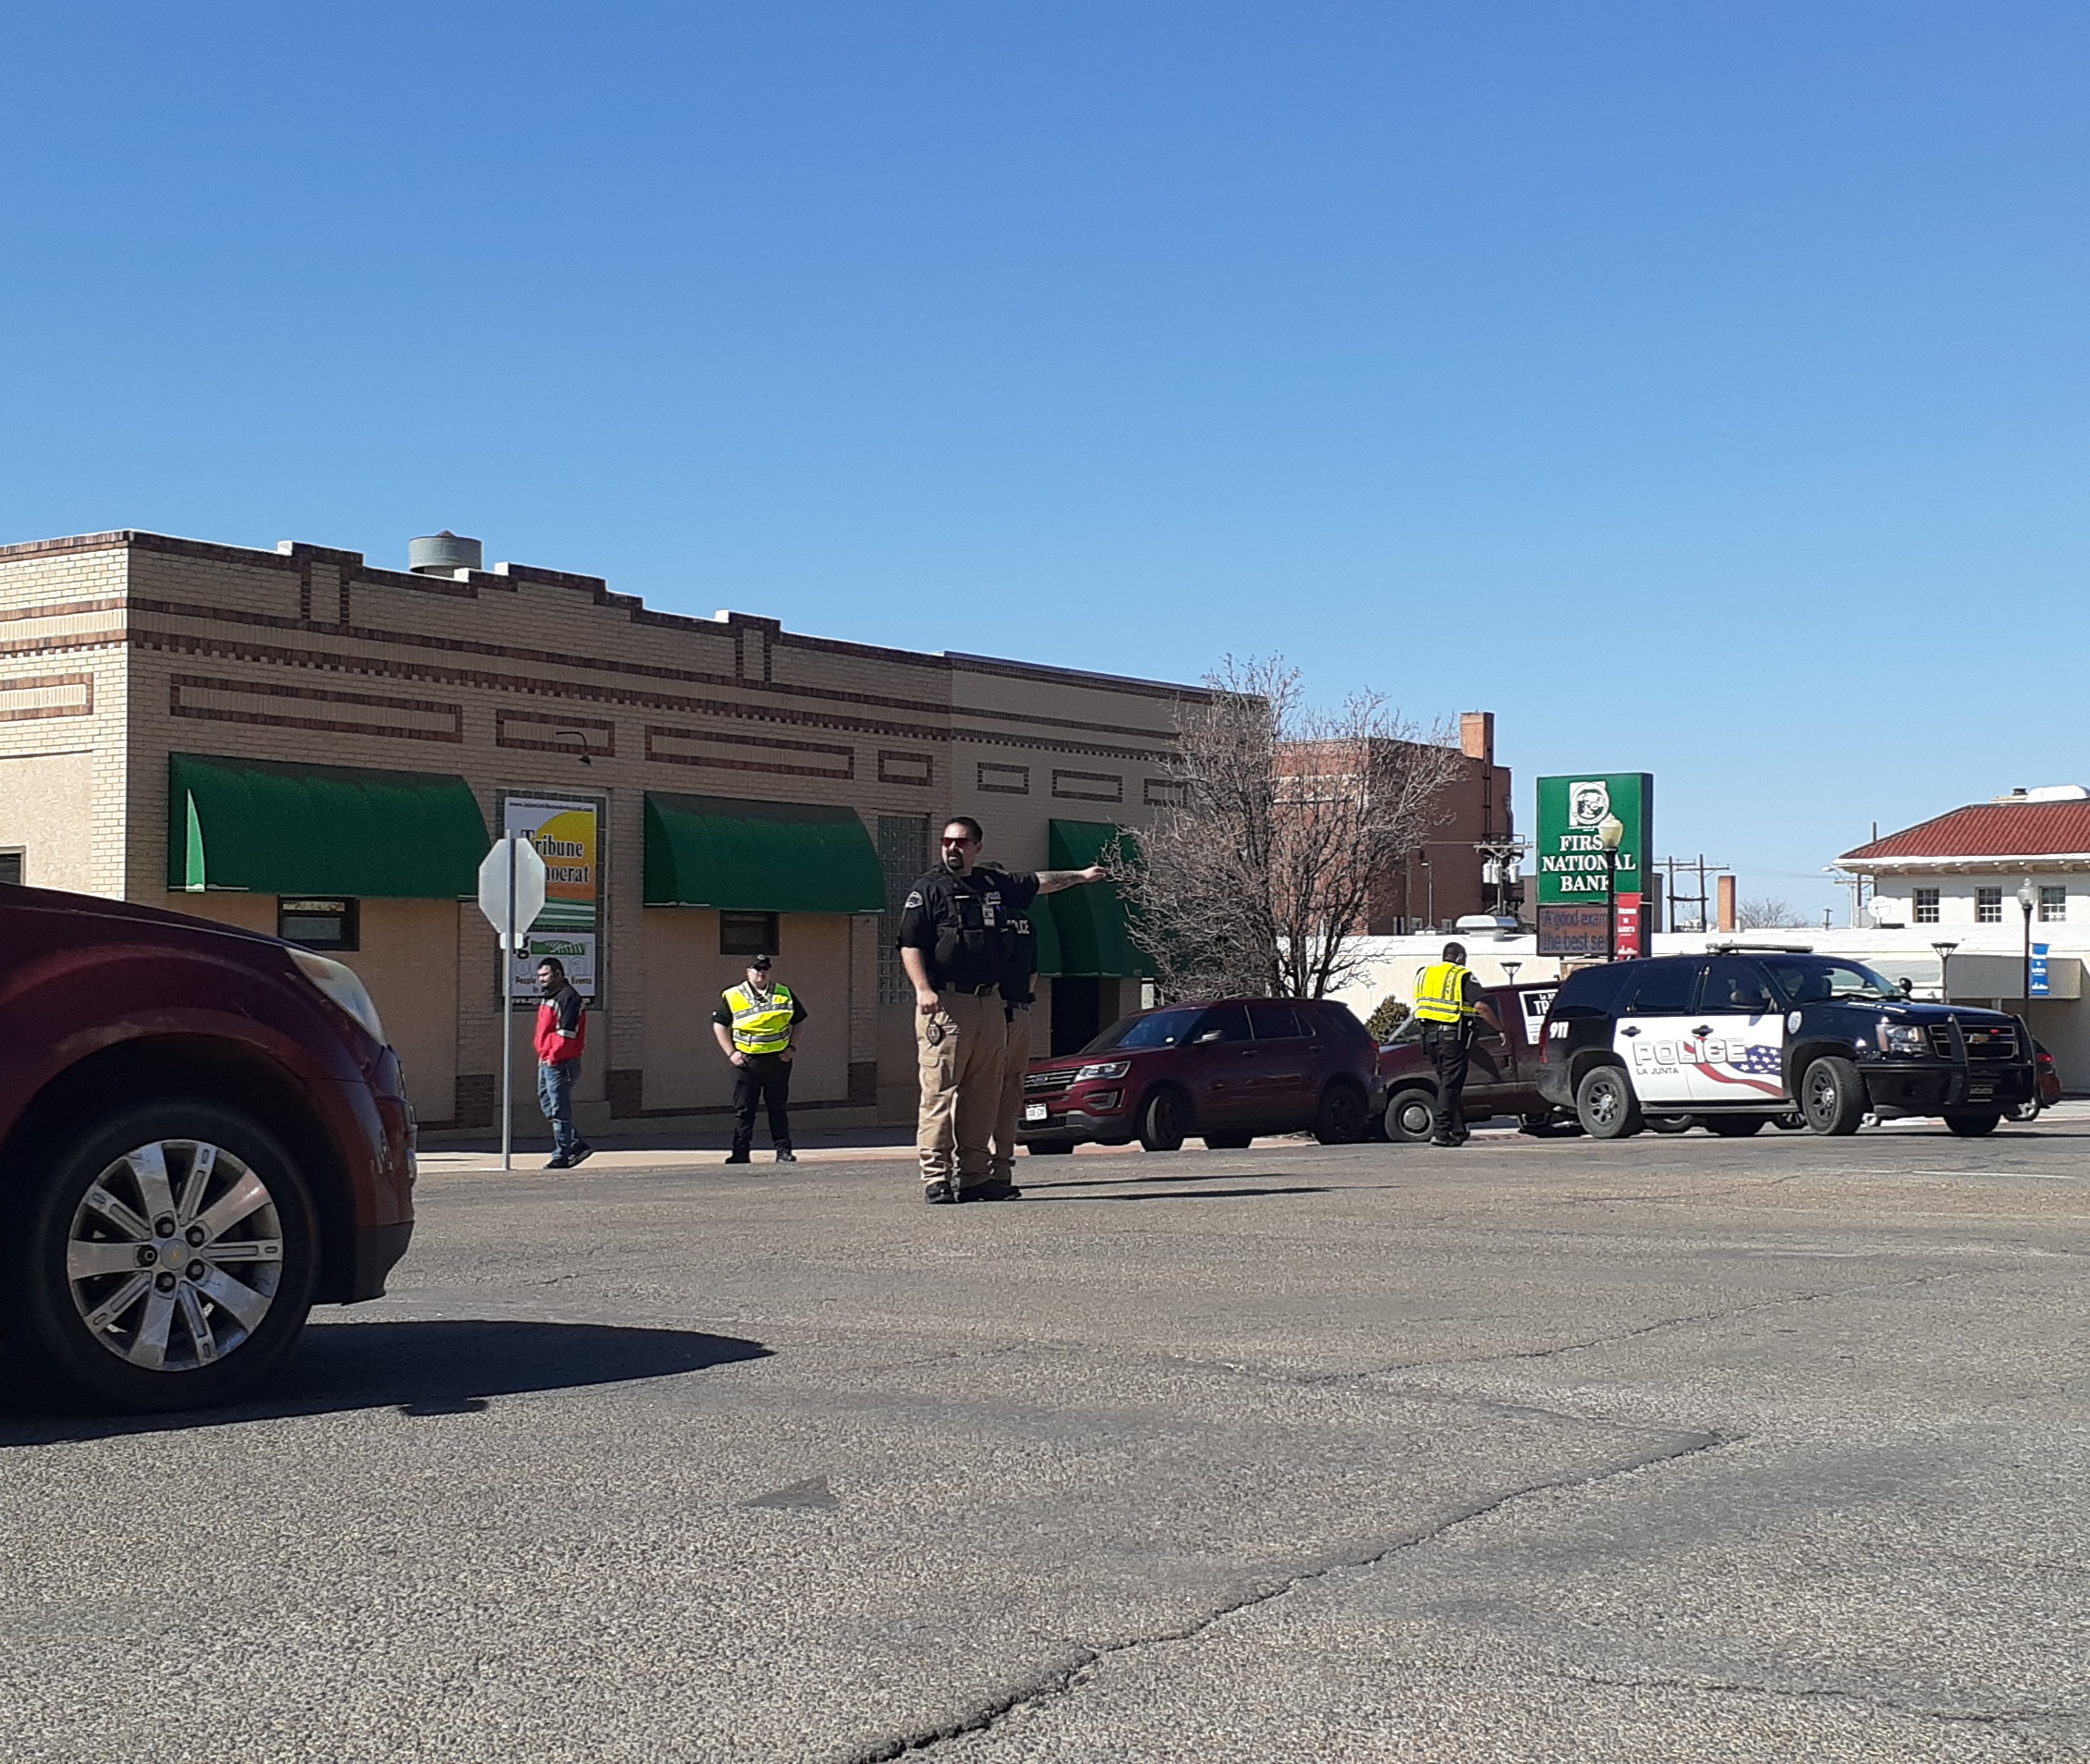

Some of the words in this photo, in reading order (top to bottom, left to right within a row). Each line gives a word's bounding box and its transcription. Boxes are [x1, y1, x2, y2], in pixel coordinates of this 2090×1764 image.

[520, 829, 583, 857] Tribune
[1559, 835, 1603, 851] FIRS
[1542, 853, 1636, 872] NATIONAL
[545, 865, 590, 883] ocrat
[1554, 909, 1579, 930] good
[1563, 931, 1588, 950] best
[1548, 1022, 1570, 1039] 911
[1632, 1039, 1748, 1065] POLICE
[1636, 1067, 1648, 1075] LA
[1650, 1066, 1680, 1075] JUNTA
